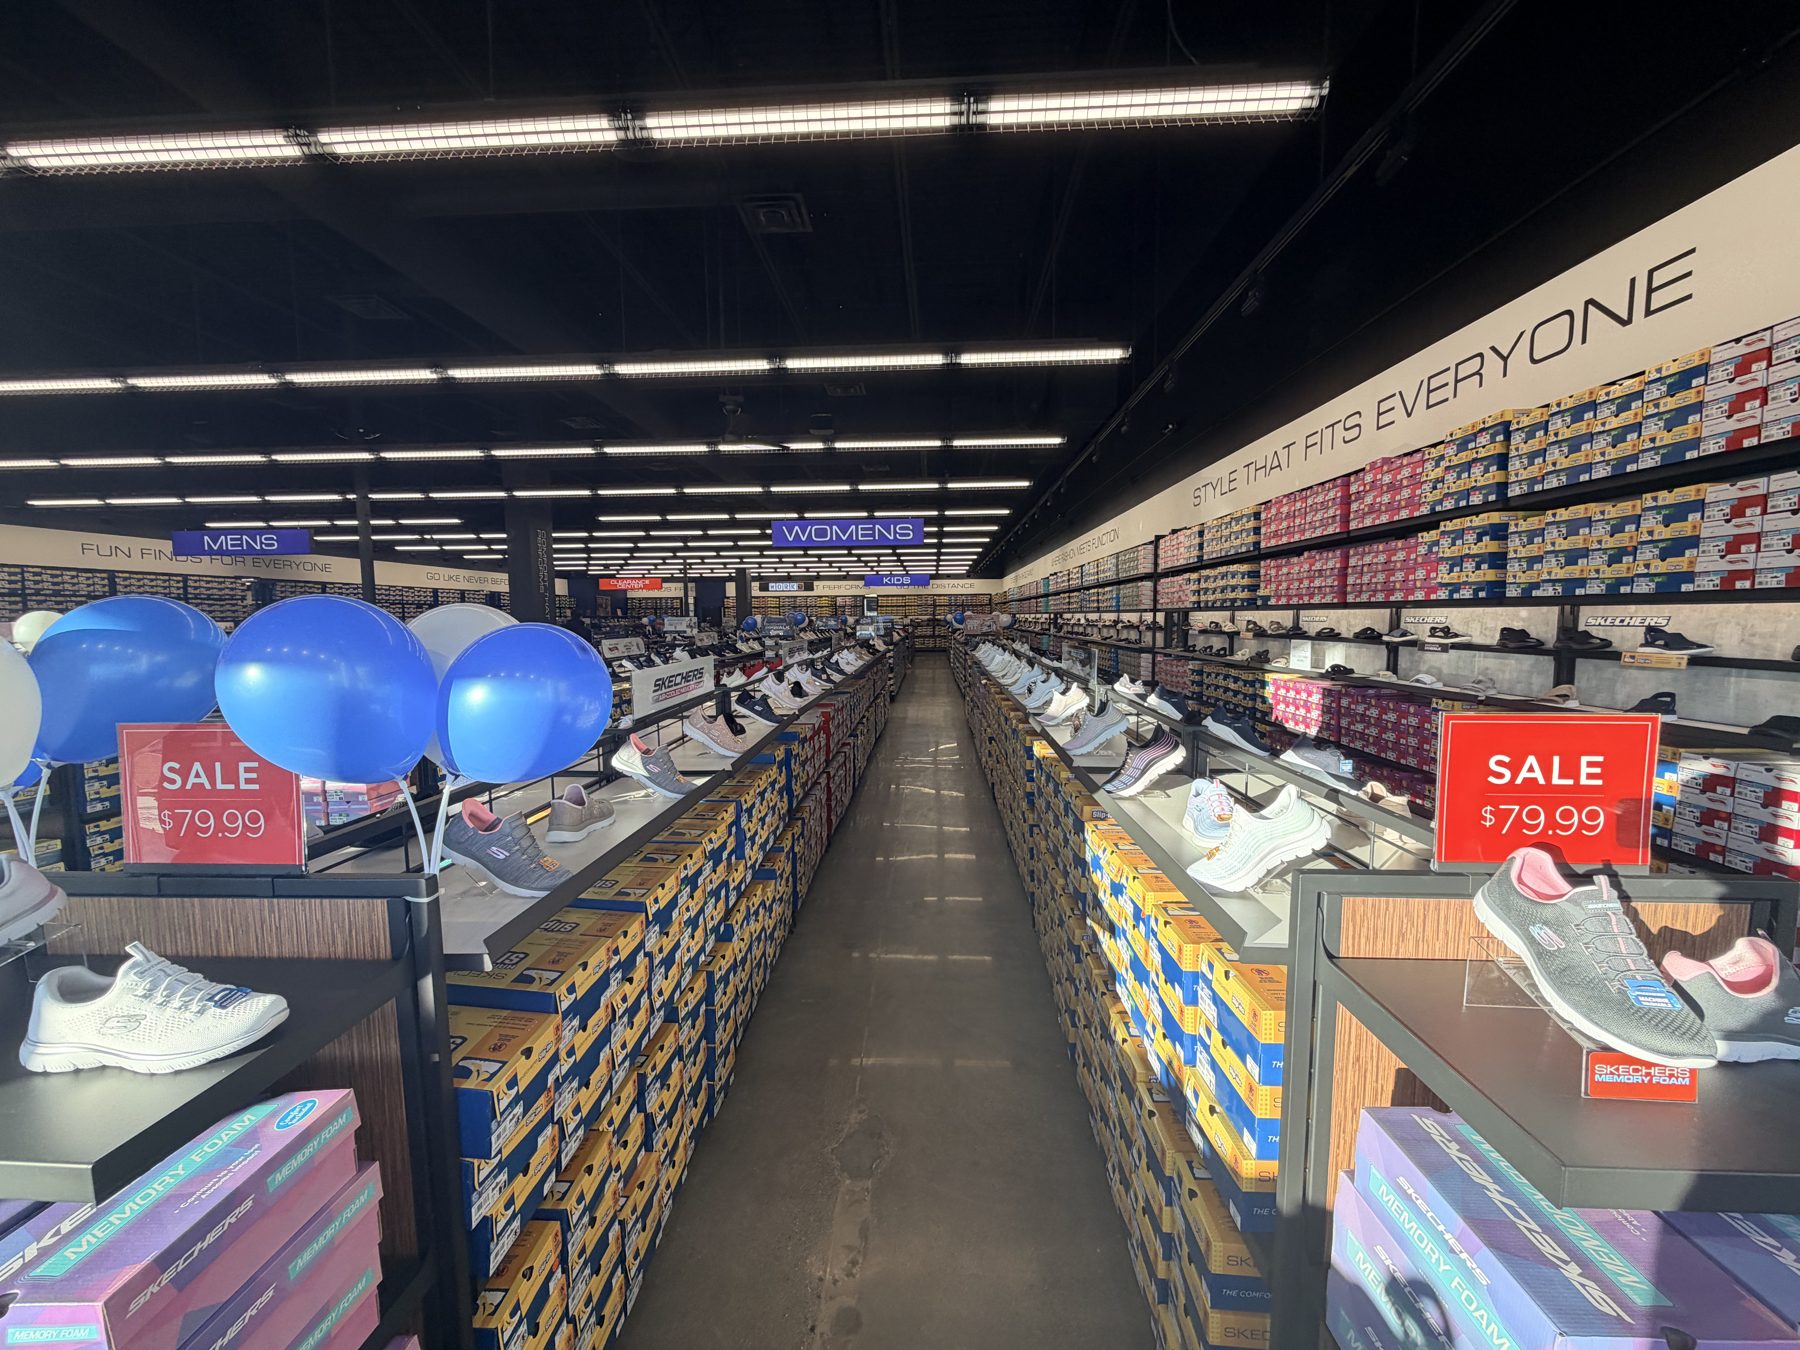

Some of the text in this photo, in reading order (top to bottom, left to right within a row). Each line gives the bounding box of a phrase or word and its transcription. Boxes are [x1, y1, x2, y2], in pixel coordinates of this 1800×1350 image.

[1193, 246, 1697, 508] STYLE THAT FITS EVERYONE
[203, 534, 278, 551] MENS
[782, 523, 914, 541] WOMENS
[81, 543, 131, 559] FUN
[209, 555, 246, 567] FOR
[252, 557, 333, 573] EVERYONE
[426, 571, 441, 581] GO
[443, 572, 461, 583] LIKE
[463, 575, 489, 585] NEVER
[883, 576, 911, 584] KIDS
[931, 582, 975, 590] DISTANCE
[1403, 615, 1448, 624] SKECHERS
[1585, 615, 1672, 627] SKECHERS
[653, 666, 705, 694] SKECHERS
[161, 761, 260, 790] SALE
[1486, 754, 1605, 786] SALE
[160, 808, 265, 838] $79.99
[1480, 804, 1605, 836] $79.99
[1594, 1064, 1690, 1077] SKECHERS
[1594, 1074, 1690, 1086] MEMORY FOAM
[274, 1113, 349, 1185] MEMORY FOAM
[64, 1114, 257, 1261] MEMORY FOAM
[295, 1188, 369, 1272] MEMORY FOAM
[1377, 1183, 1452, 1273] MEMORY
[1395, 1175, 1492, 1287] SKECHERS
[1410, 1113, 1636, 1325] SKECHERS
[125, 1192, 256, 1320] SKECHERS
[339, 1277, 367, 1308] FOAM
[1222, 1288, 1238, 1297] THE
[15, 1327, 90, 1340] MEMORY FOAM
